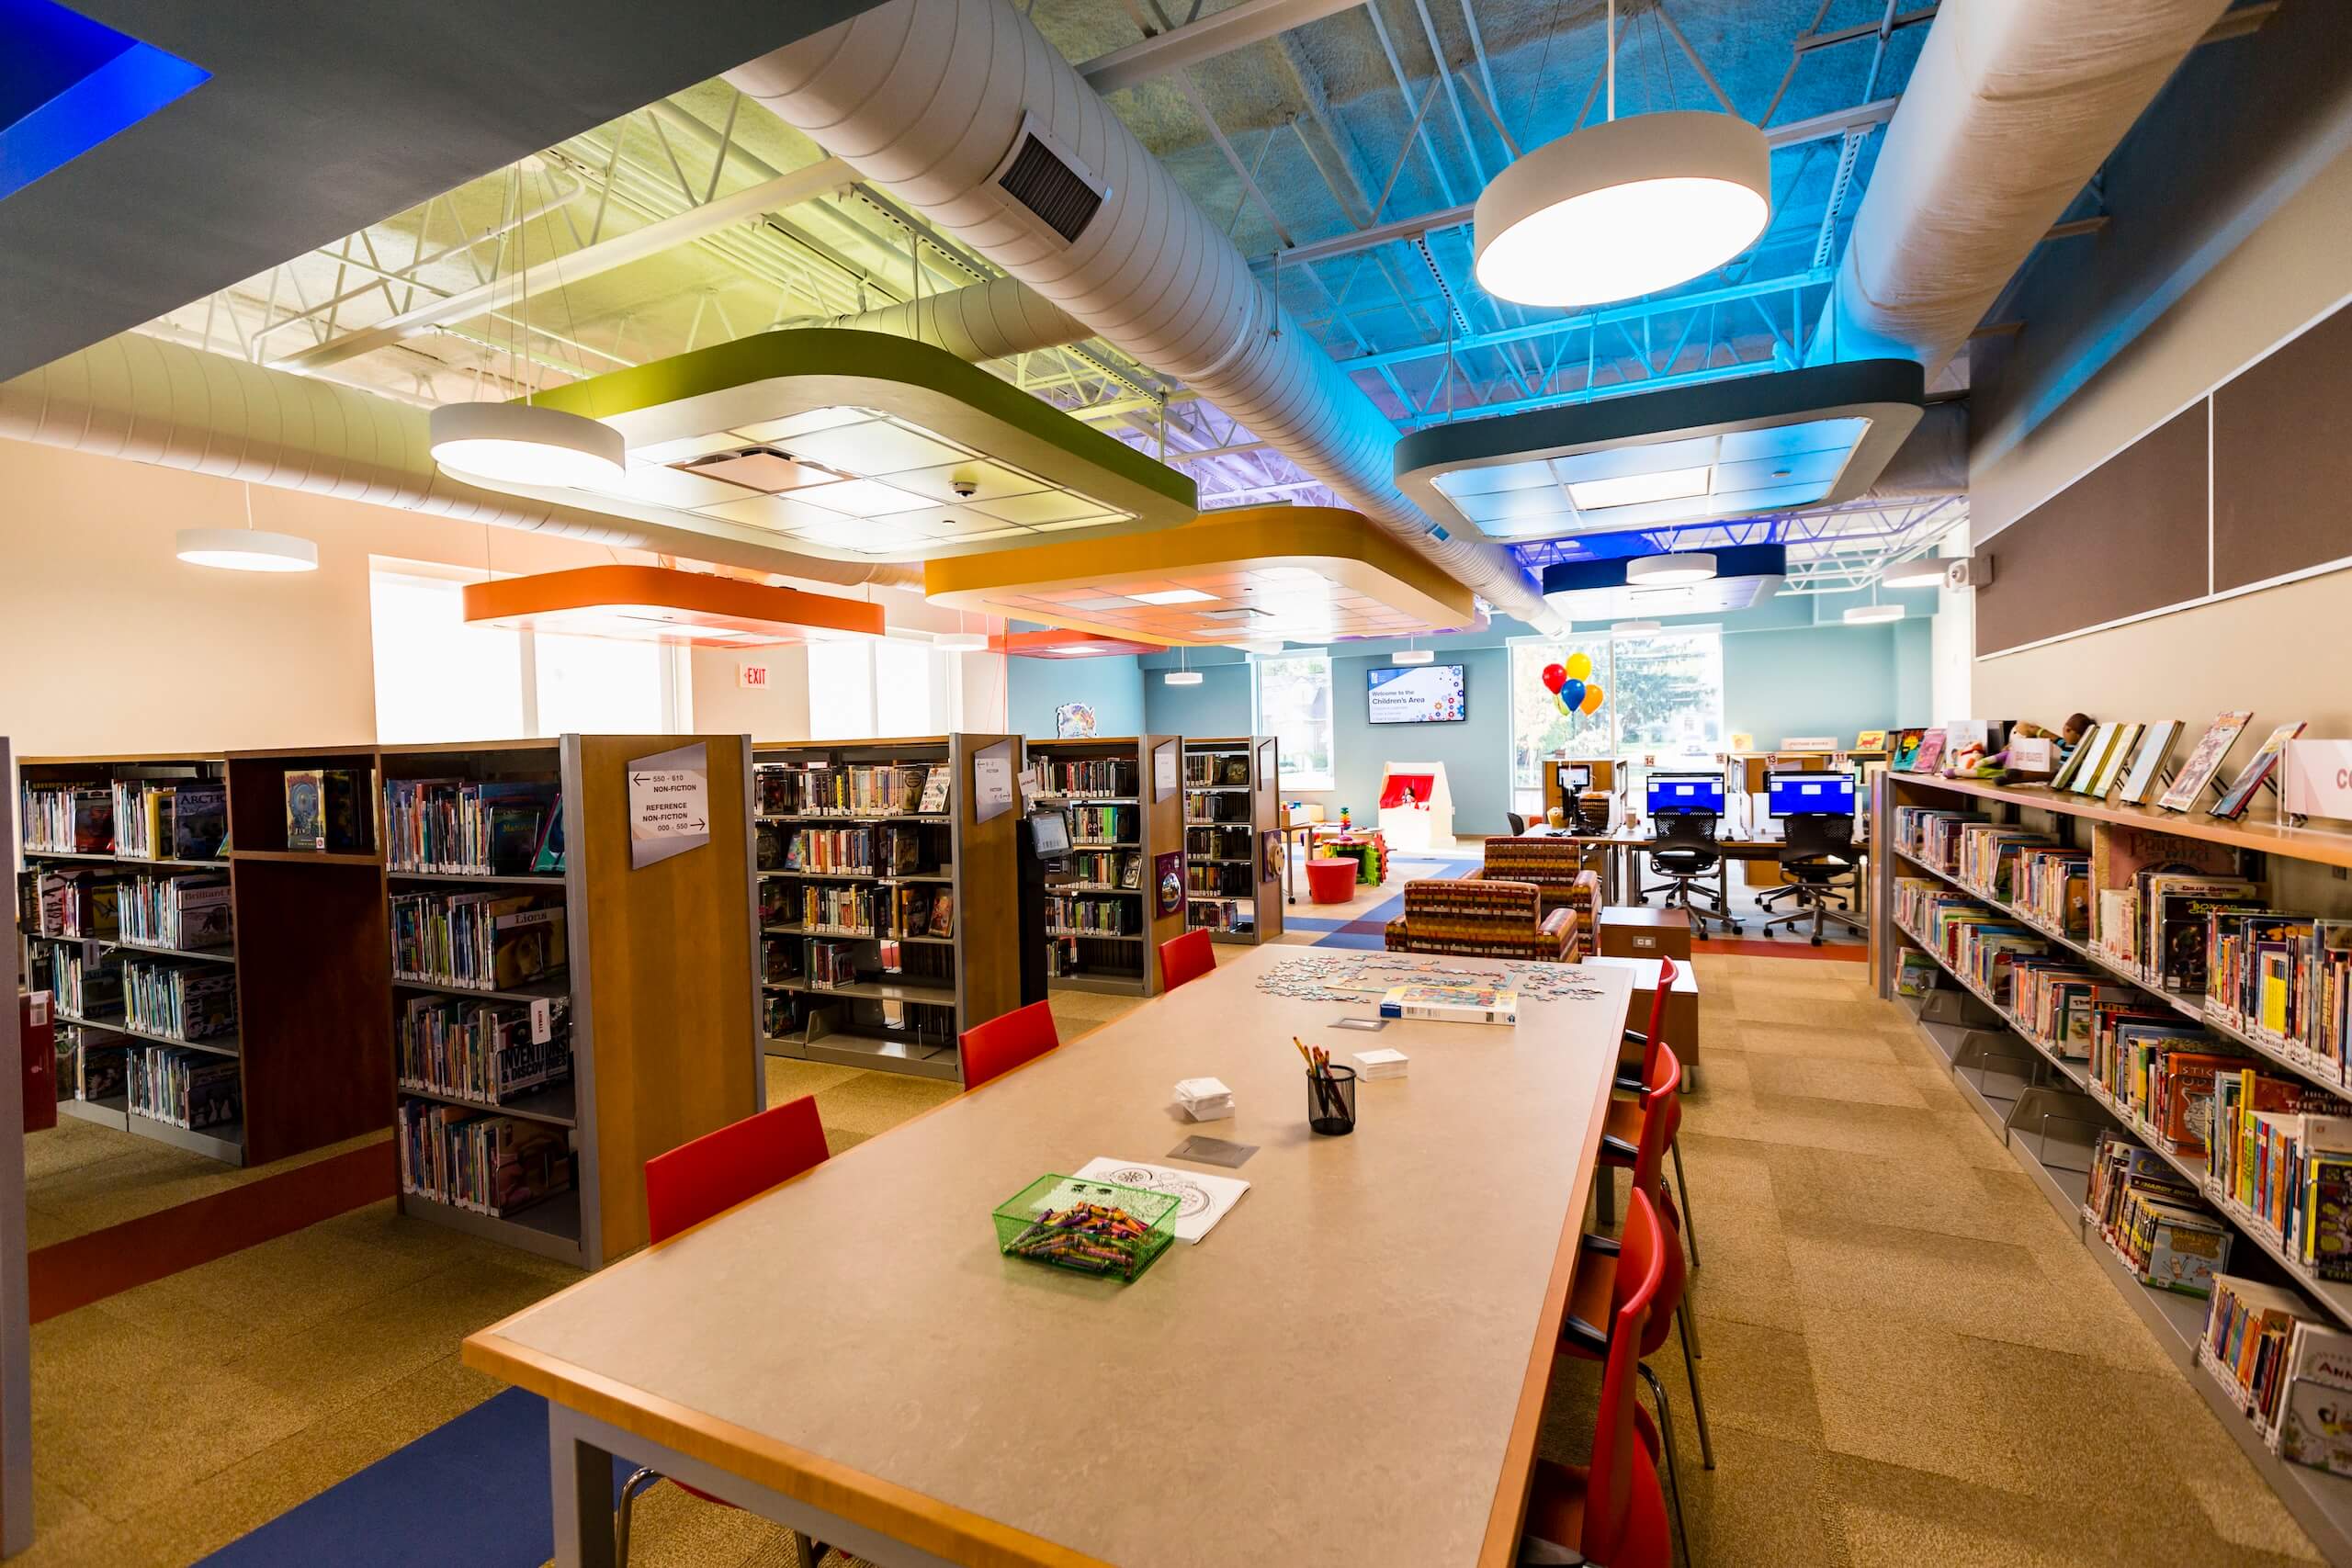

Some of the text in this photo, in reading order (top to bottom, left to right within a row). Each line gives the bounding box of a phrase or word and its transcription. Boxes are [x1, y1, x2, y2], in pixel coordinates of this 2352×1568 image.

[748, 668, 765, 684] EXIT
[1645, 757, 1654, 765] 14
[1767, 755, 1776, 763] 13
[2336, 768, 2352, 790] C
[653, 784, 696, 793] NON-FICTION
[646, 802, 687, 811] REFERENCE
[642, 813, 688, 822] NON-FICTION
[515, 910, 548, 924] Lions
